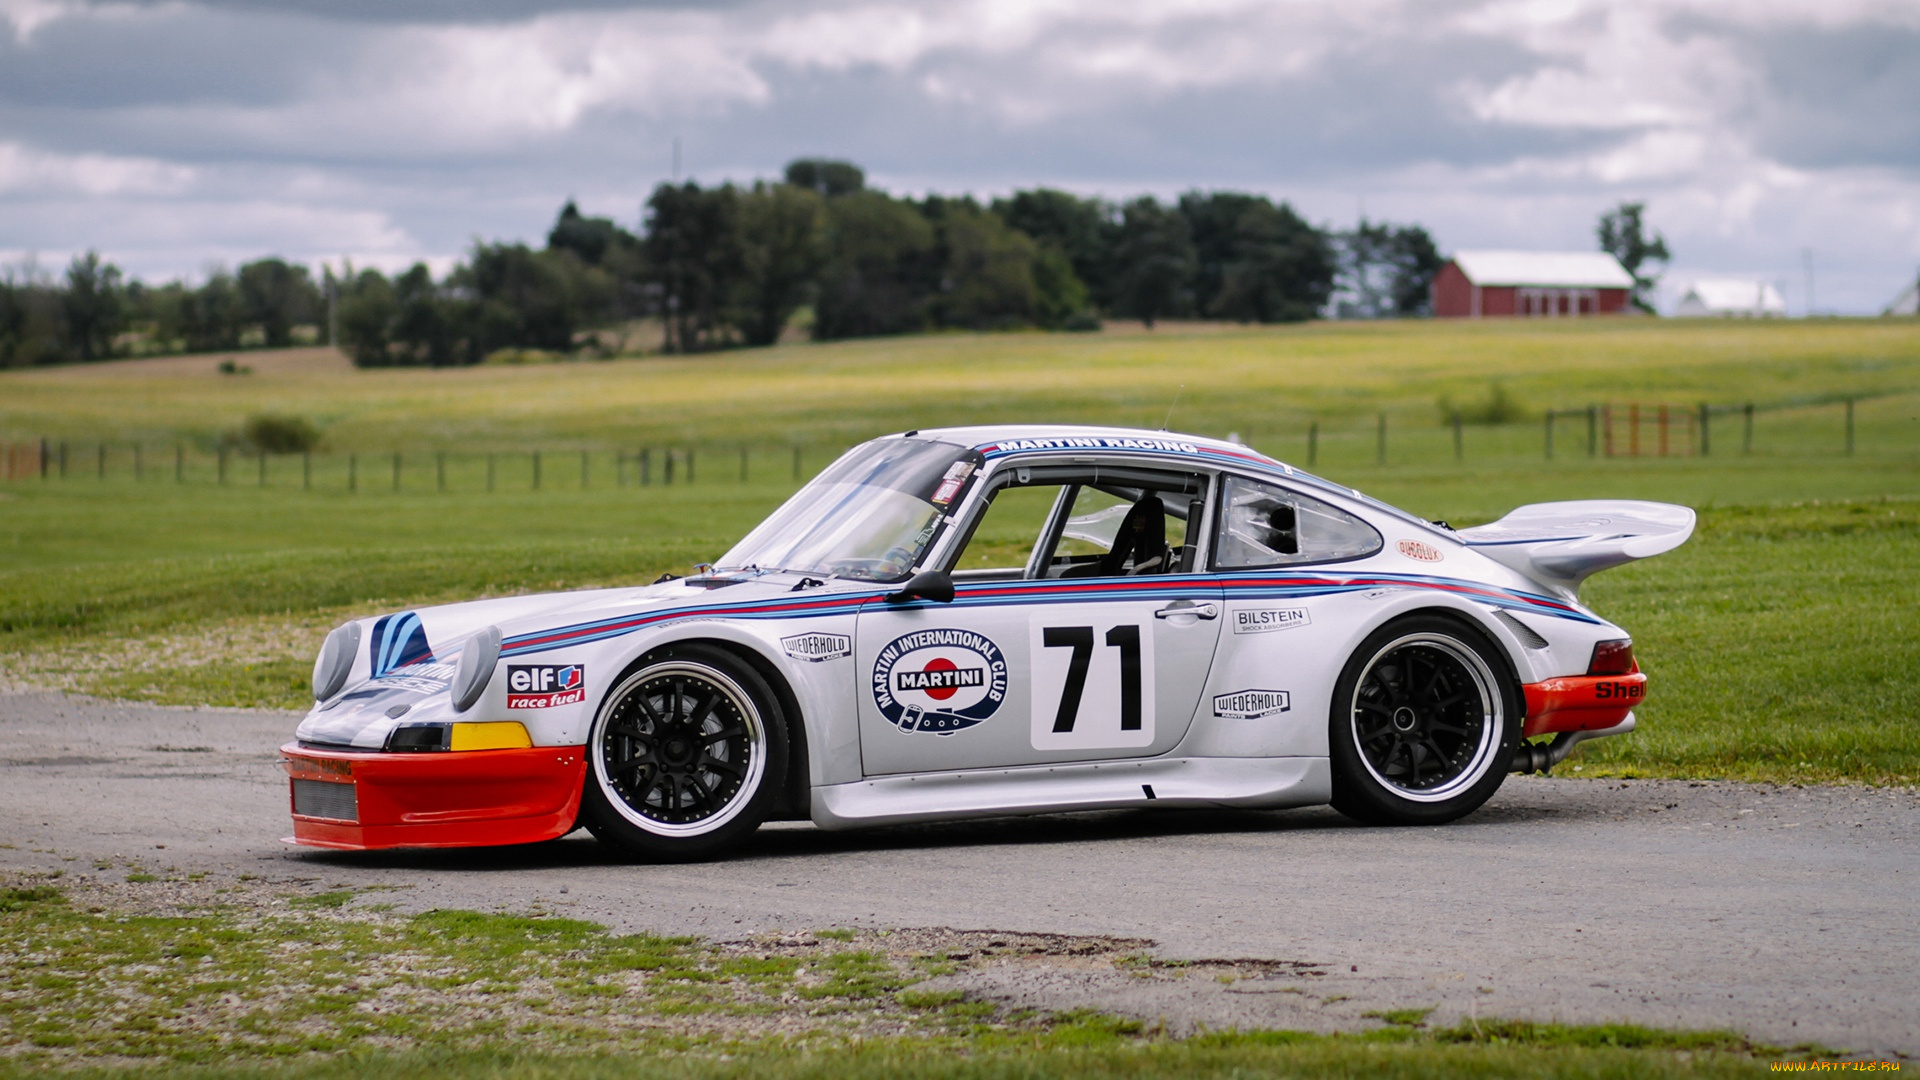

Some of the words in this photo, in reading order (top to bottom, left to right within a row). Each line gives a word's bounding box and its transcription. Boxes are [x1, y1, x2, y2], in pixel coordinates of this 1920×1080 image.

[997, 438, 1100, 452] MARTINI
[1104, 438, 1199, 454] RACING
[1238, 610, 1304, 625] BILSTEIN
[1241, 624, 1263, 632] SHOCK
[1263, 620, 1303, 631] ABSORBERS
[785, 636, 846, 655] WIEDERHOLD
[874, 645, 900, 709] MARTINI
[897, 630, 997, 660] INTERNATIONAL
[989, 660, 1006, 703] CLUB
[900, 669, 981, 689] MARTINI
[1042, 624, 1142, 733] 71
[510, 668, 555, 692] elf
[510, 698, 547, 708] race
[549, 689, 582, 706] fuel
[1218, 693, 1284, 712] WIEDERHOLD
[321, 759, 353, 776] RACING
